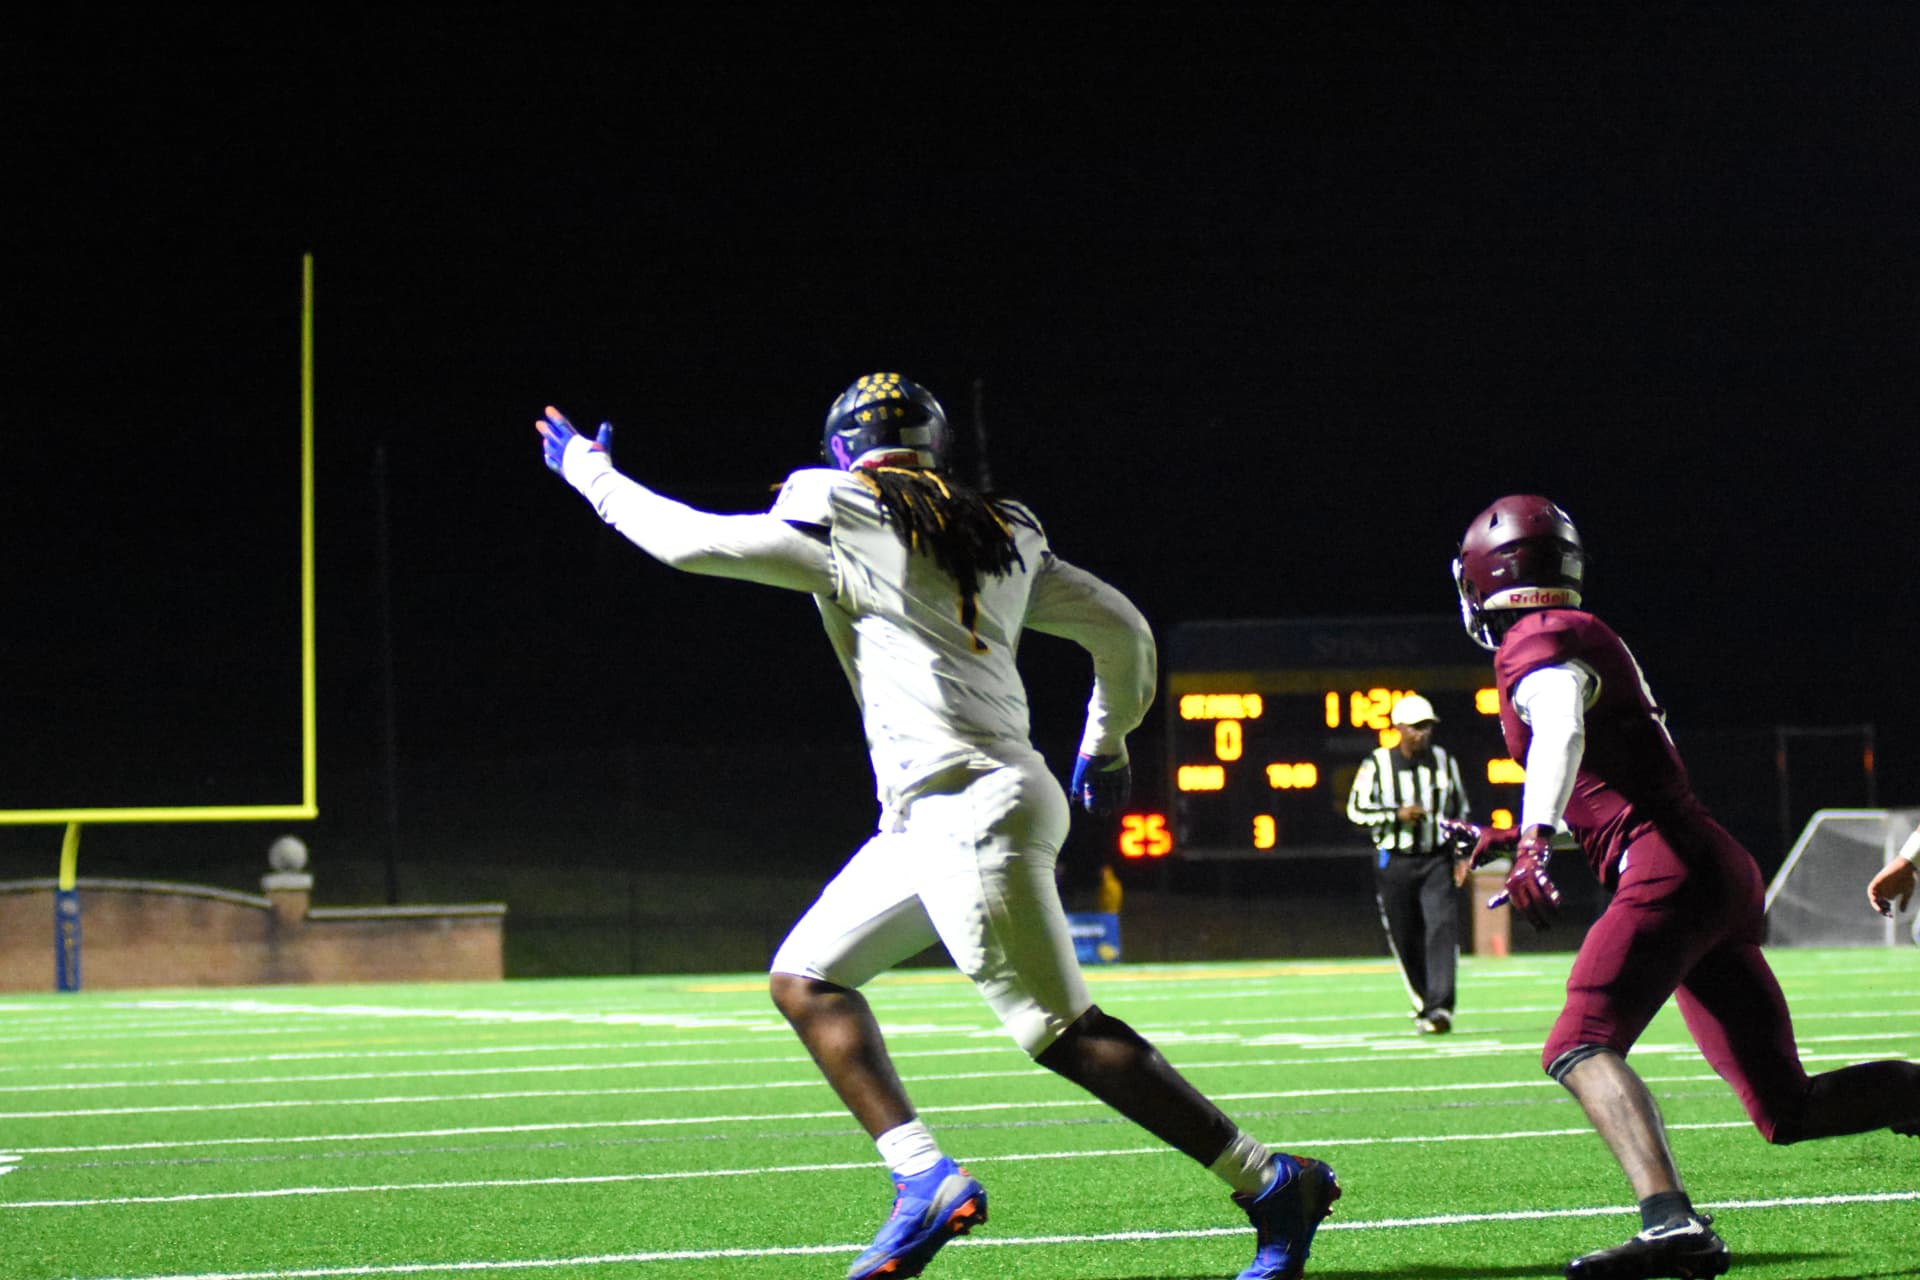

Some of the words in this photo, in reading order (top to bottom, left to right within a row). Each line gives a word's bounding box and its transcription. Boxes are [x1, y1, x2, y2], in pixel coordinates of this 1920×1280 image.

[1215, 720, 1242, 761] 0
[1120, 814, 1172, 857] 25
[1253, 814, 1276, 849] 3
